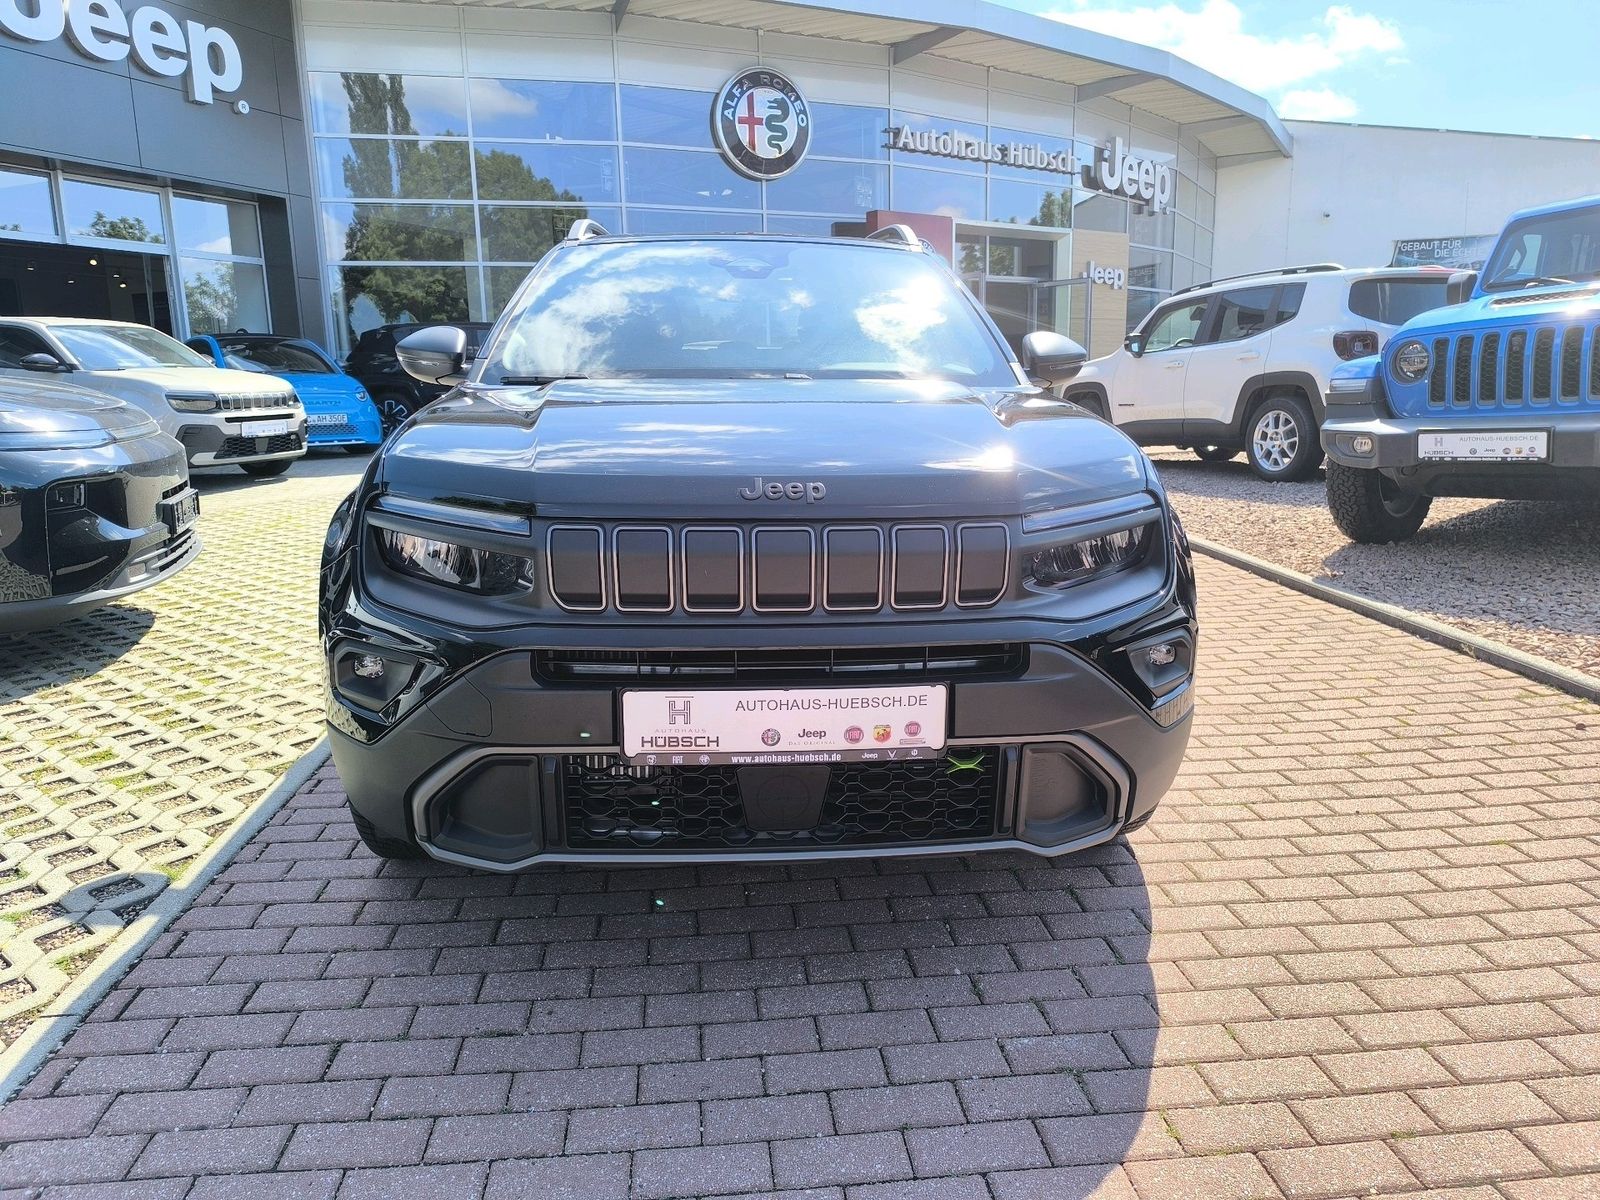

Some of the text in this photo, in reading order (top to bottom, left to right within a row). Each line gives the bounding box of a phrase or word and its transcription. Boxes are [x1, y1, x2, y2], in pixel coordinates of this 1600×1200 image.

[724, 75, 807, 127] ALFA ROMEO
[898, 124, 1076, 173] Autohaus Hübsch
[1102, 136, 1171, 213] Jeep
[1401, 239, 1462, 251] GEBAUT FÜR
[1434, 249, 1450, 258] DIE
[738, 477, 826, 504] Jeep
[735, 694, 928, 712] AUTOHAUS-HUEBSCH.DE
[798, 728, 827, 740] Jeep
[641, 736, 720, 748] HÜBSCH
[731, 752, 842, 764] www.autohaus-huebsch.de
[861, 752, 879, 760] Jeep
